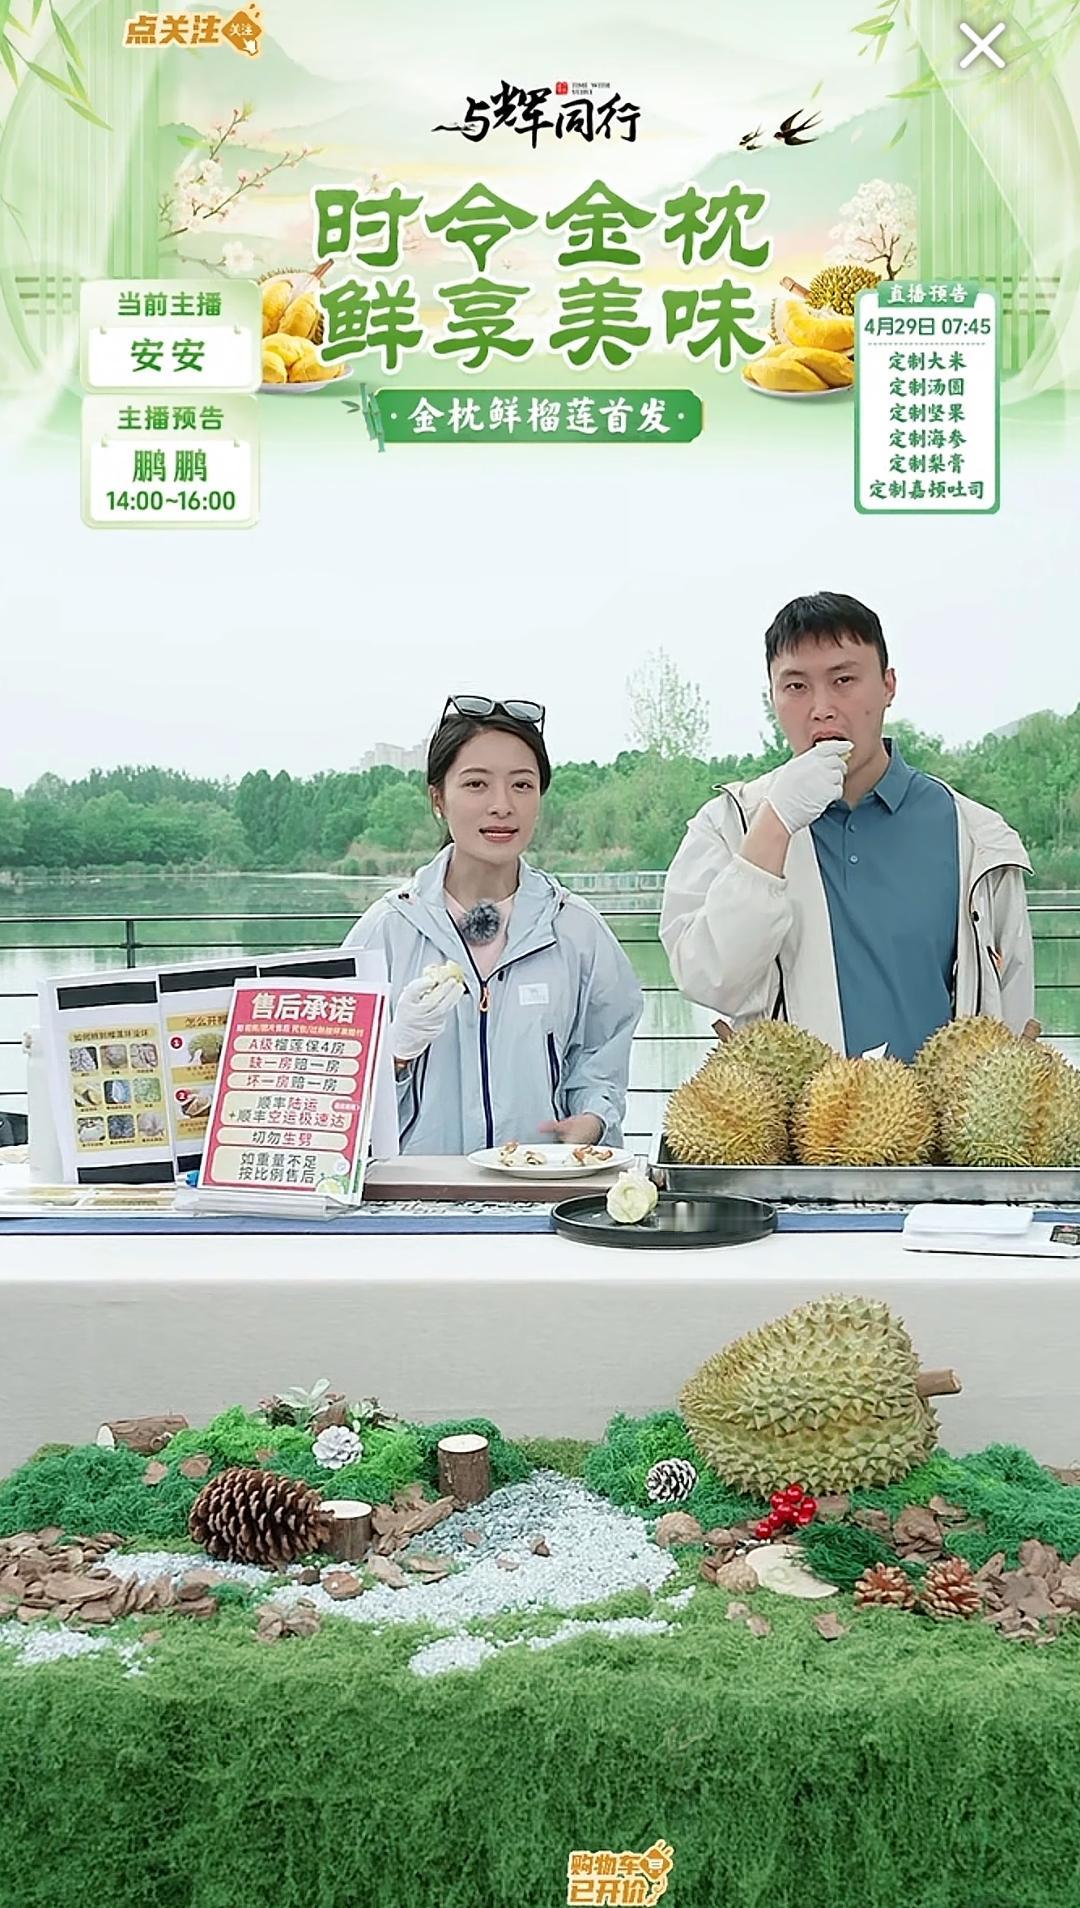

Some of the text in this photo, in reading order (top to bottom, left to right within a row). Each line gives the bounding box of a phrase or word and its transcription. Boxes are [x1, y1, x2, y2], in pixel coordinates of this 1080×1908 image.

[251, 992, 357, 1024] 售后承诺
[248, 1038, 346, 1055] A级榴莲保4房
[248, 1056, 340, 1073] 缺一房赔一房
[246, 1074, 338, 1091] 坏一房赔一房
[257, 1095, 319, 1112] 顺丰陆运
[240, 1151, 317, 1170] 如重量不足
[238, 1166, 316, 1184] 按比例售后
